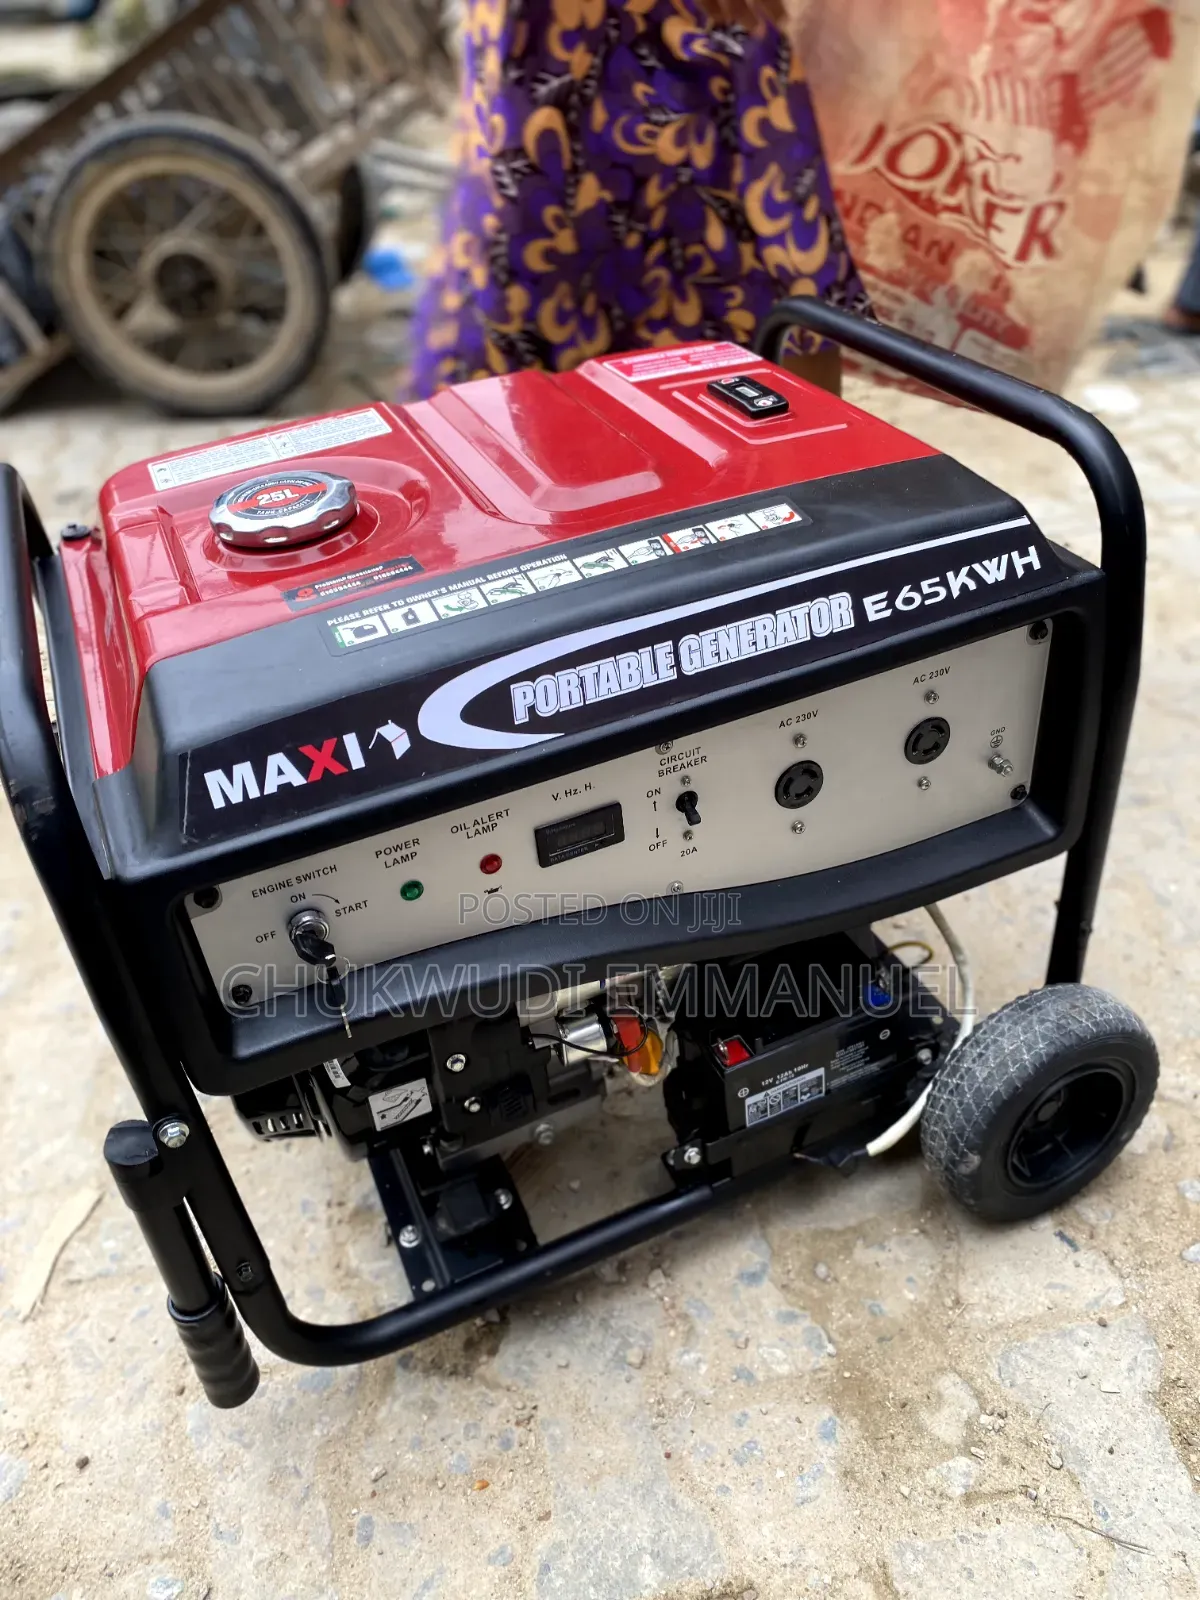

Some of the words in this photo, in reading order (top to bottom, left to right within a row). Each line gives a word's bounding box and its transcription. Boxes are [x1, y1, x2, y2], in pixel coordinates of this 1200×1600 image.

[256, 488, 299, 506] 25L
[327, 611, 361, 626] PLEASE
[362, 604, 391, 616] REFER
[391, 598, 405, 608] TO
[406, 584, 447, 602] OWNER'S
[448, 576, 487, 592] MANUAL
[487, 566, 519, 581] BEFORE
[520, 554, 568, 571] OPERATION
[862, 544, 1042, 622] E65KWH
[510, 640, 677, 725] PORTABLE
[678, 591, 855, 676] GENERATOR
[913, 674, 926, 685] AC
[929, 666, 951, 680] 230V
[778, 716, 793, 729] AC
[795, 709, 819, 724] 230V
[990, 726, 1006, 737] GND
[659, 746, 702, 767] CIRCUIT
[204, 732, 366, 810] MAXI
[658, 755, 708, 778] BREAKER
[646, 787, 662, 799] ON
[450, 821, 471, 835] OIL
[472, 808, 511, 828] ALERT
[466, 822, 499, 840] LAMP
[375, 838, 421, 859] POWER
[648, 839, 668, 852] OFF
[680, 846, 698, 858] 20A
[384, 851, 418, 869] LAMP
[251, 878, 294, 899] ENGINE
[295, 864, 338, 885] SWITCH
[290, 892, 307, 904] ON
[334, 900, 369, 918] START
[255, 930, 277, 944] OFF
